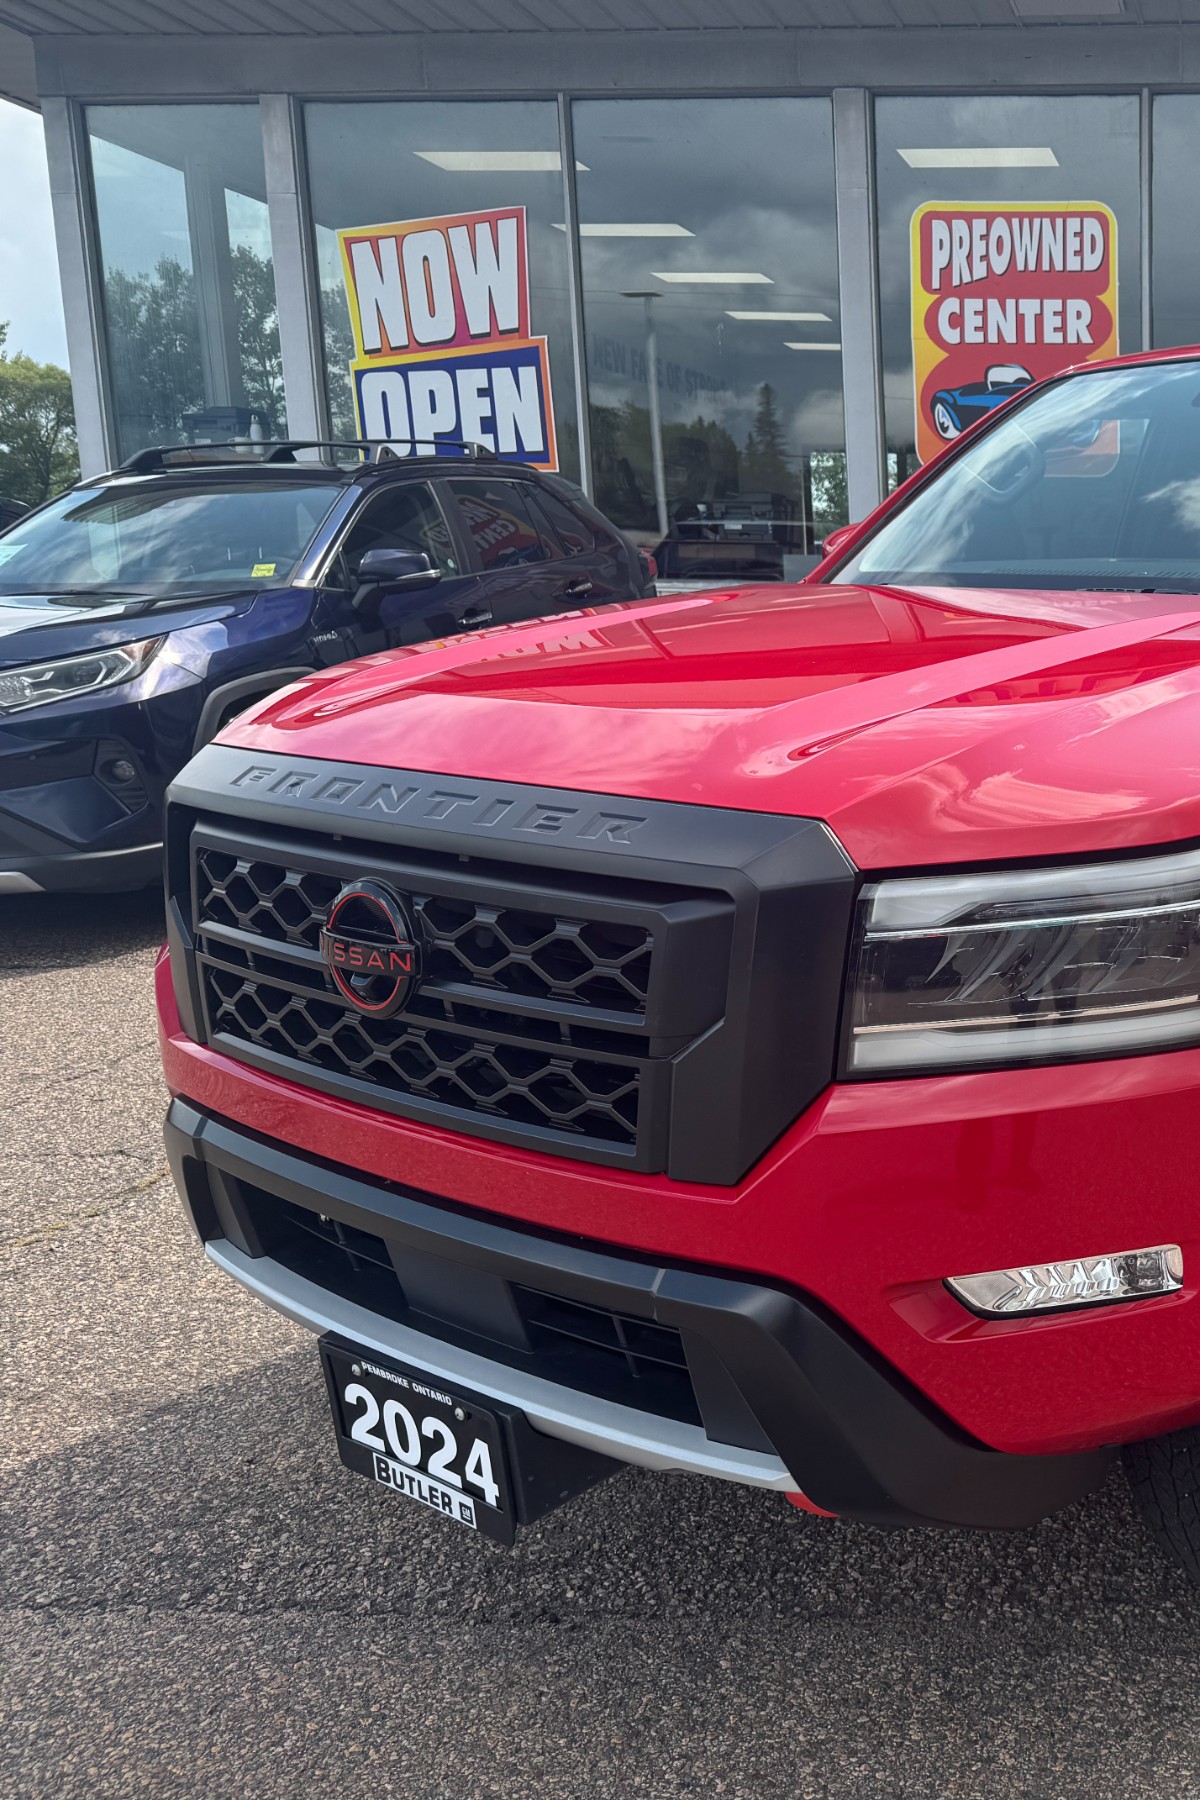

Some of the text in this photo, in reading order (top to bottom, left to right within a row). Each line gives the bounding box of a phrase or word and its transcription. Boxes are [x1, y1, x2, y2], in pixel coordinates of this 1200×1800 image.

[350, 217, 520, 355] NOW
[931, 217, 1105, 290] PREOWNED
[937, 297, 1095, 345] CENTER
[630, 348, 663, 388] FAE
[361, 366, 544, 457] OPEN
[229, 765, 650, 845] FRONTIER
[360, 1361, 453, 1406] PEMBROKE ONTARIO
[344, 1383, 500, 1507] 2024
[376, 1457, 454, 1516] BUTLER
